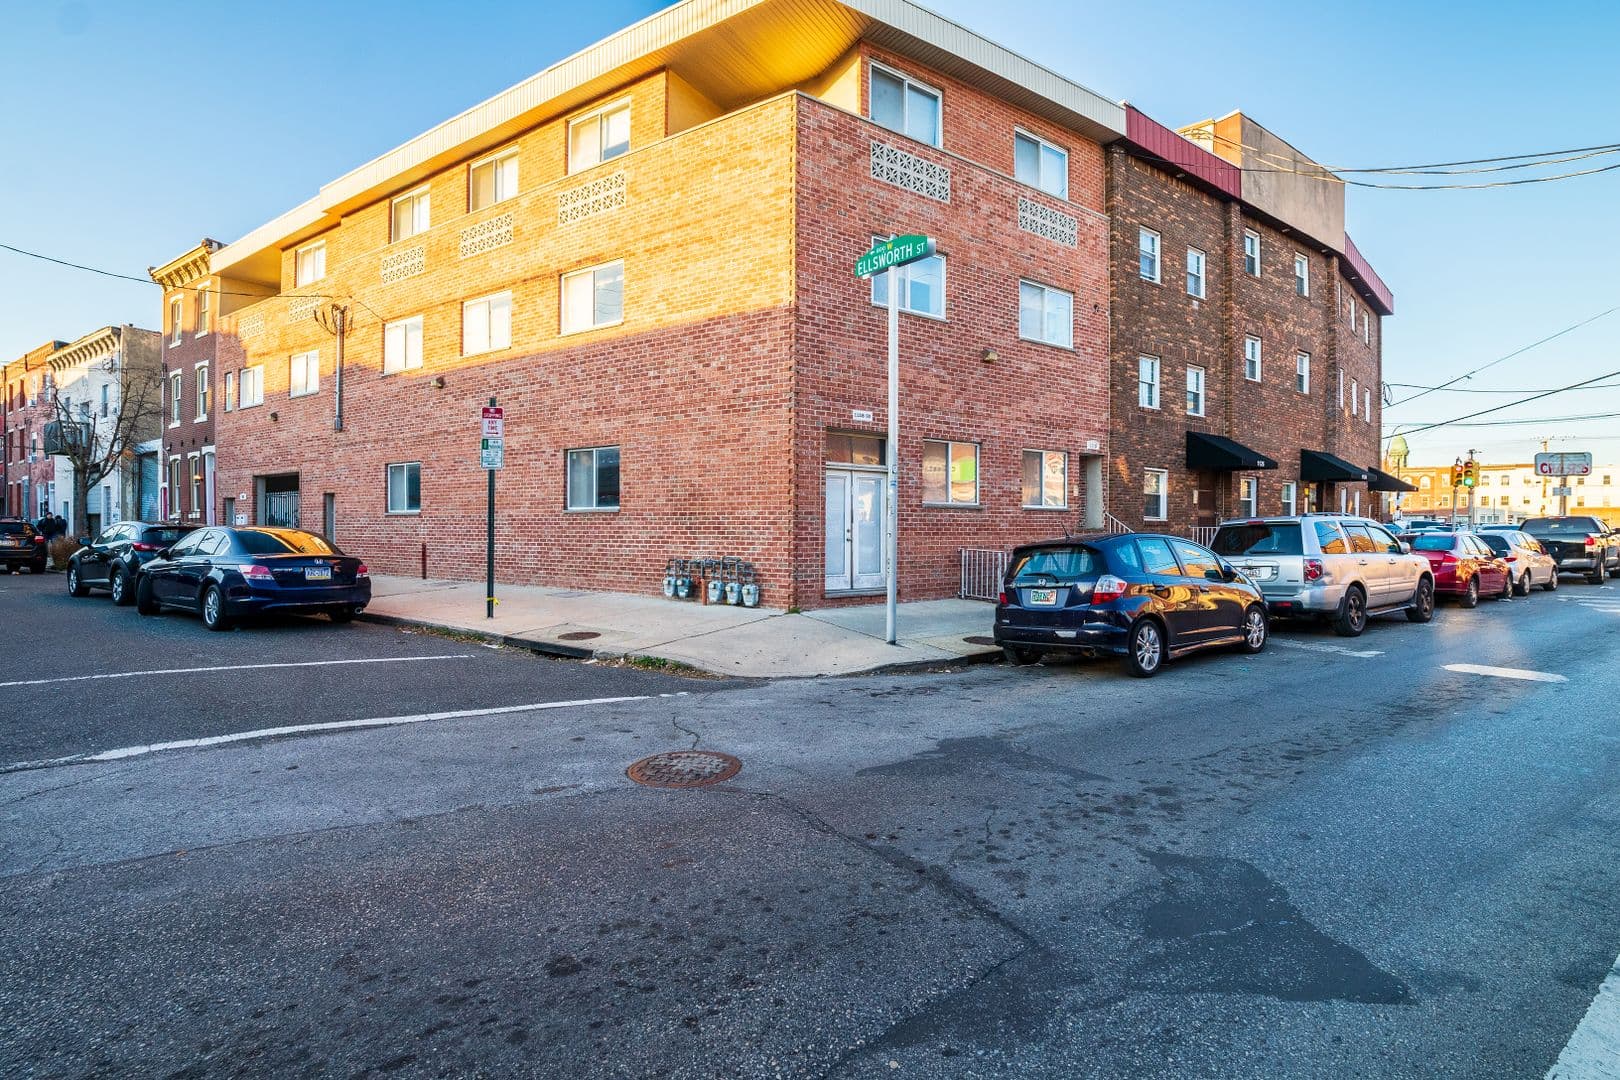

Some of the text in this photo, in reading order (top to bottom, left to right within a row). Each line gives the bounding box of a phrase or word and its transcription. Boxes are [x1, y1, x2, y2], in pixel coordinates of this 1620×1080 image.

[887, 242, 893, 251] W
[857, 242, 925, 276] ELLSWORTH ST
